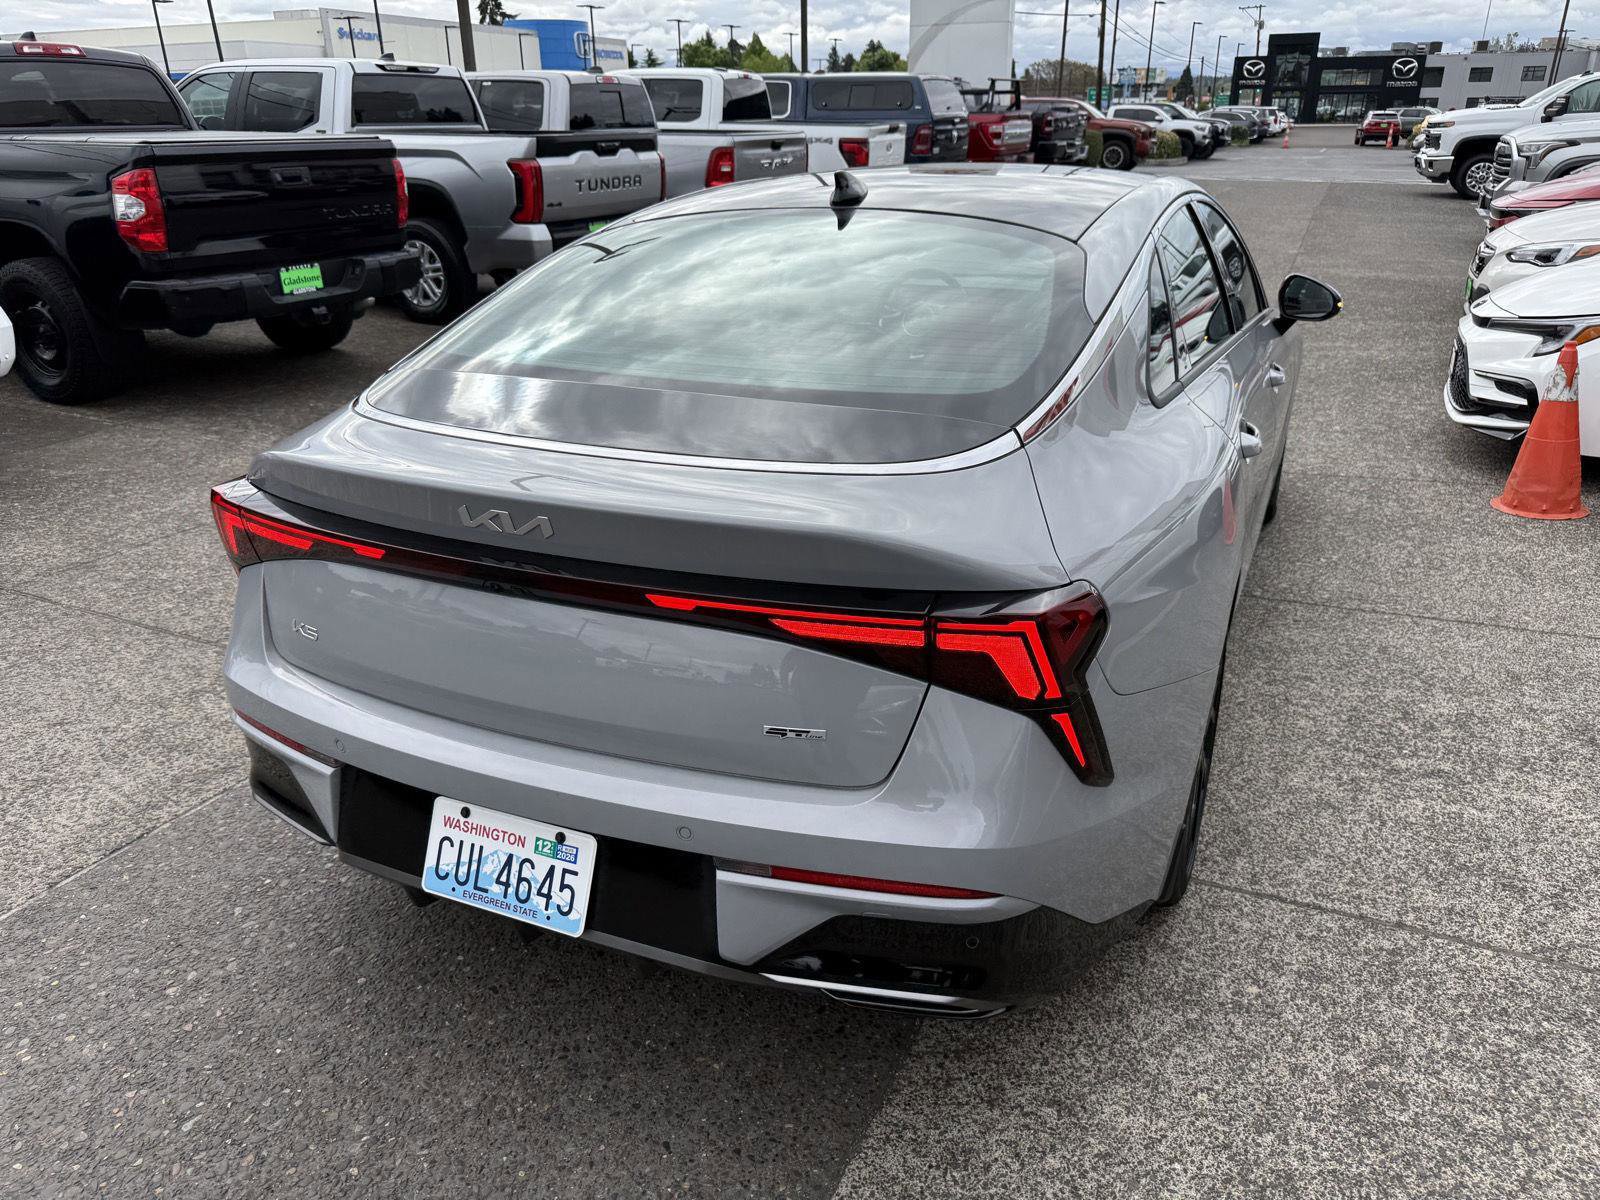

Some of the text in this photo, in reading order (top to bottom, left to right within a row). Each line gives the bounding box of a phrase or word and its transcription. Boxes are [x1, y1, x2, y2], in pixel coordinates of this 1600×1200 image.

[1386, 80, 1418, 88] mazda
[574, 175, 643, 195] TUNDRA
[283, 275, 320, 286] Gladstone
[458, 504, 554, 539] KIA
[292, 618, 319, 641] K5
[443, 815, 526, 848] WASHINGTON
[536, 839, 552, 853] 12
[556, 851, 575, 862] 2026
[435, 836, 578, 916] CUL4645
[463, 890, 538, 918] EVERGREEN STATE
